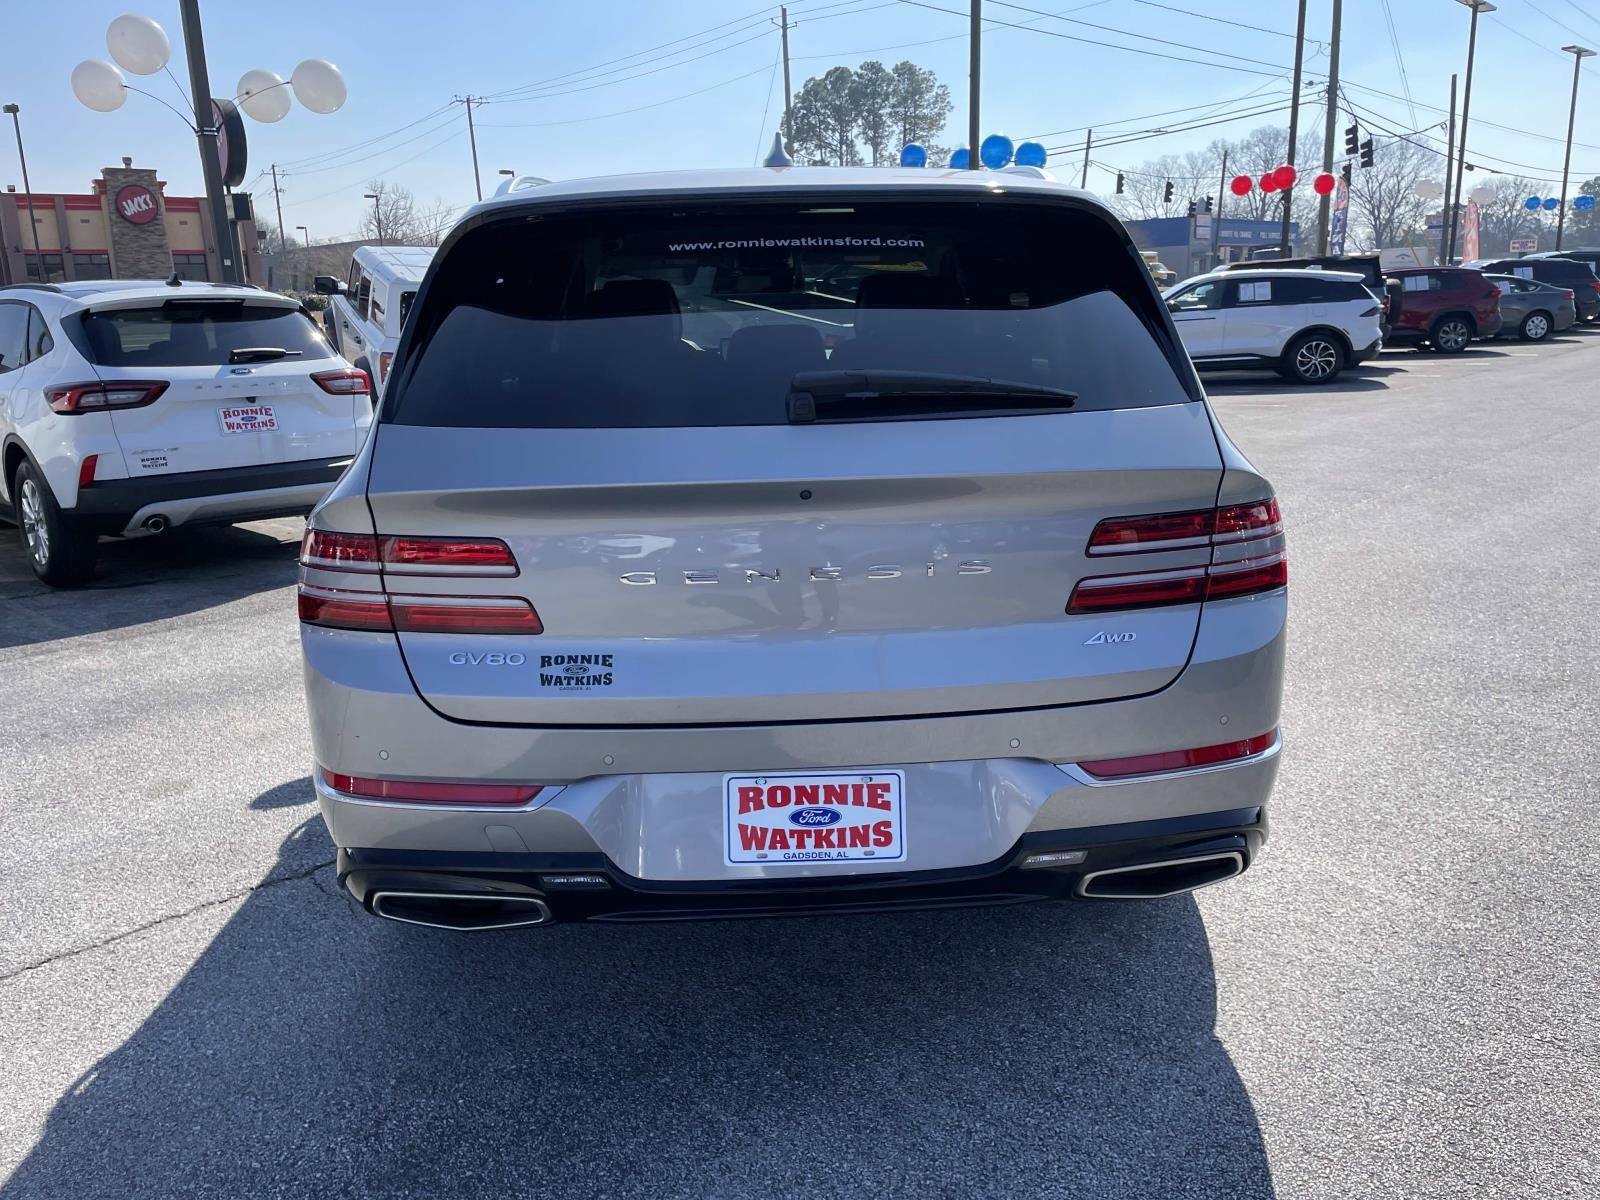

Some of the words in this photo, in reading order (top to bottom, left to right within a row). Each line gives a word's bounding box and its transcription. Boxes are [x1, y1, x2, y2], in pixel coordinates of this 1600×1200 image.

[669, 237, 925, 251] www.ronniewatkinsford.com
[222, 407, 273, 420] RONNIE
[225, 418, 275, 431] WATKINS
[619, 559, 993, 586] GENESIS
[1084, 631, 1137, 645] AWD
[449, 652, 526, 666] GV80
[540, 654, 613, 668] RONNIE
[539, 672, 613, 687] WATKINS
[738, 783, 892, 815] RONNIE
[799, 810, 832, 824] Ford
[738, 820, 893, 851] WATKINS
[783, 852, 835, 860] GADSDEN,
